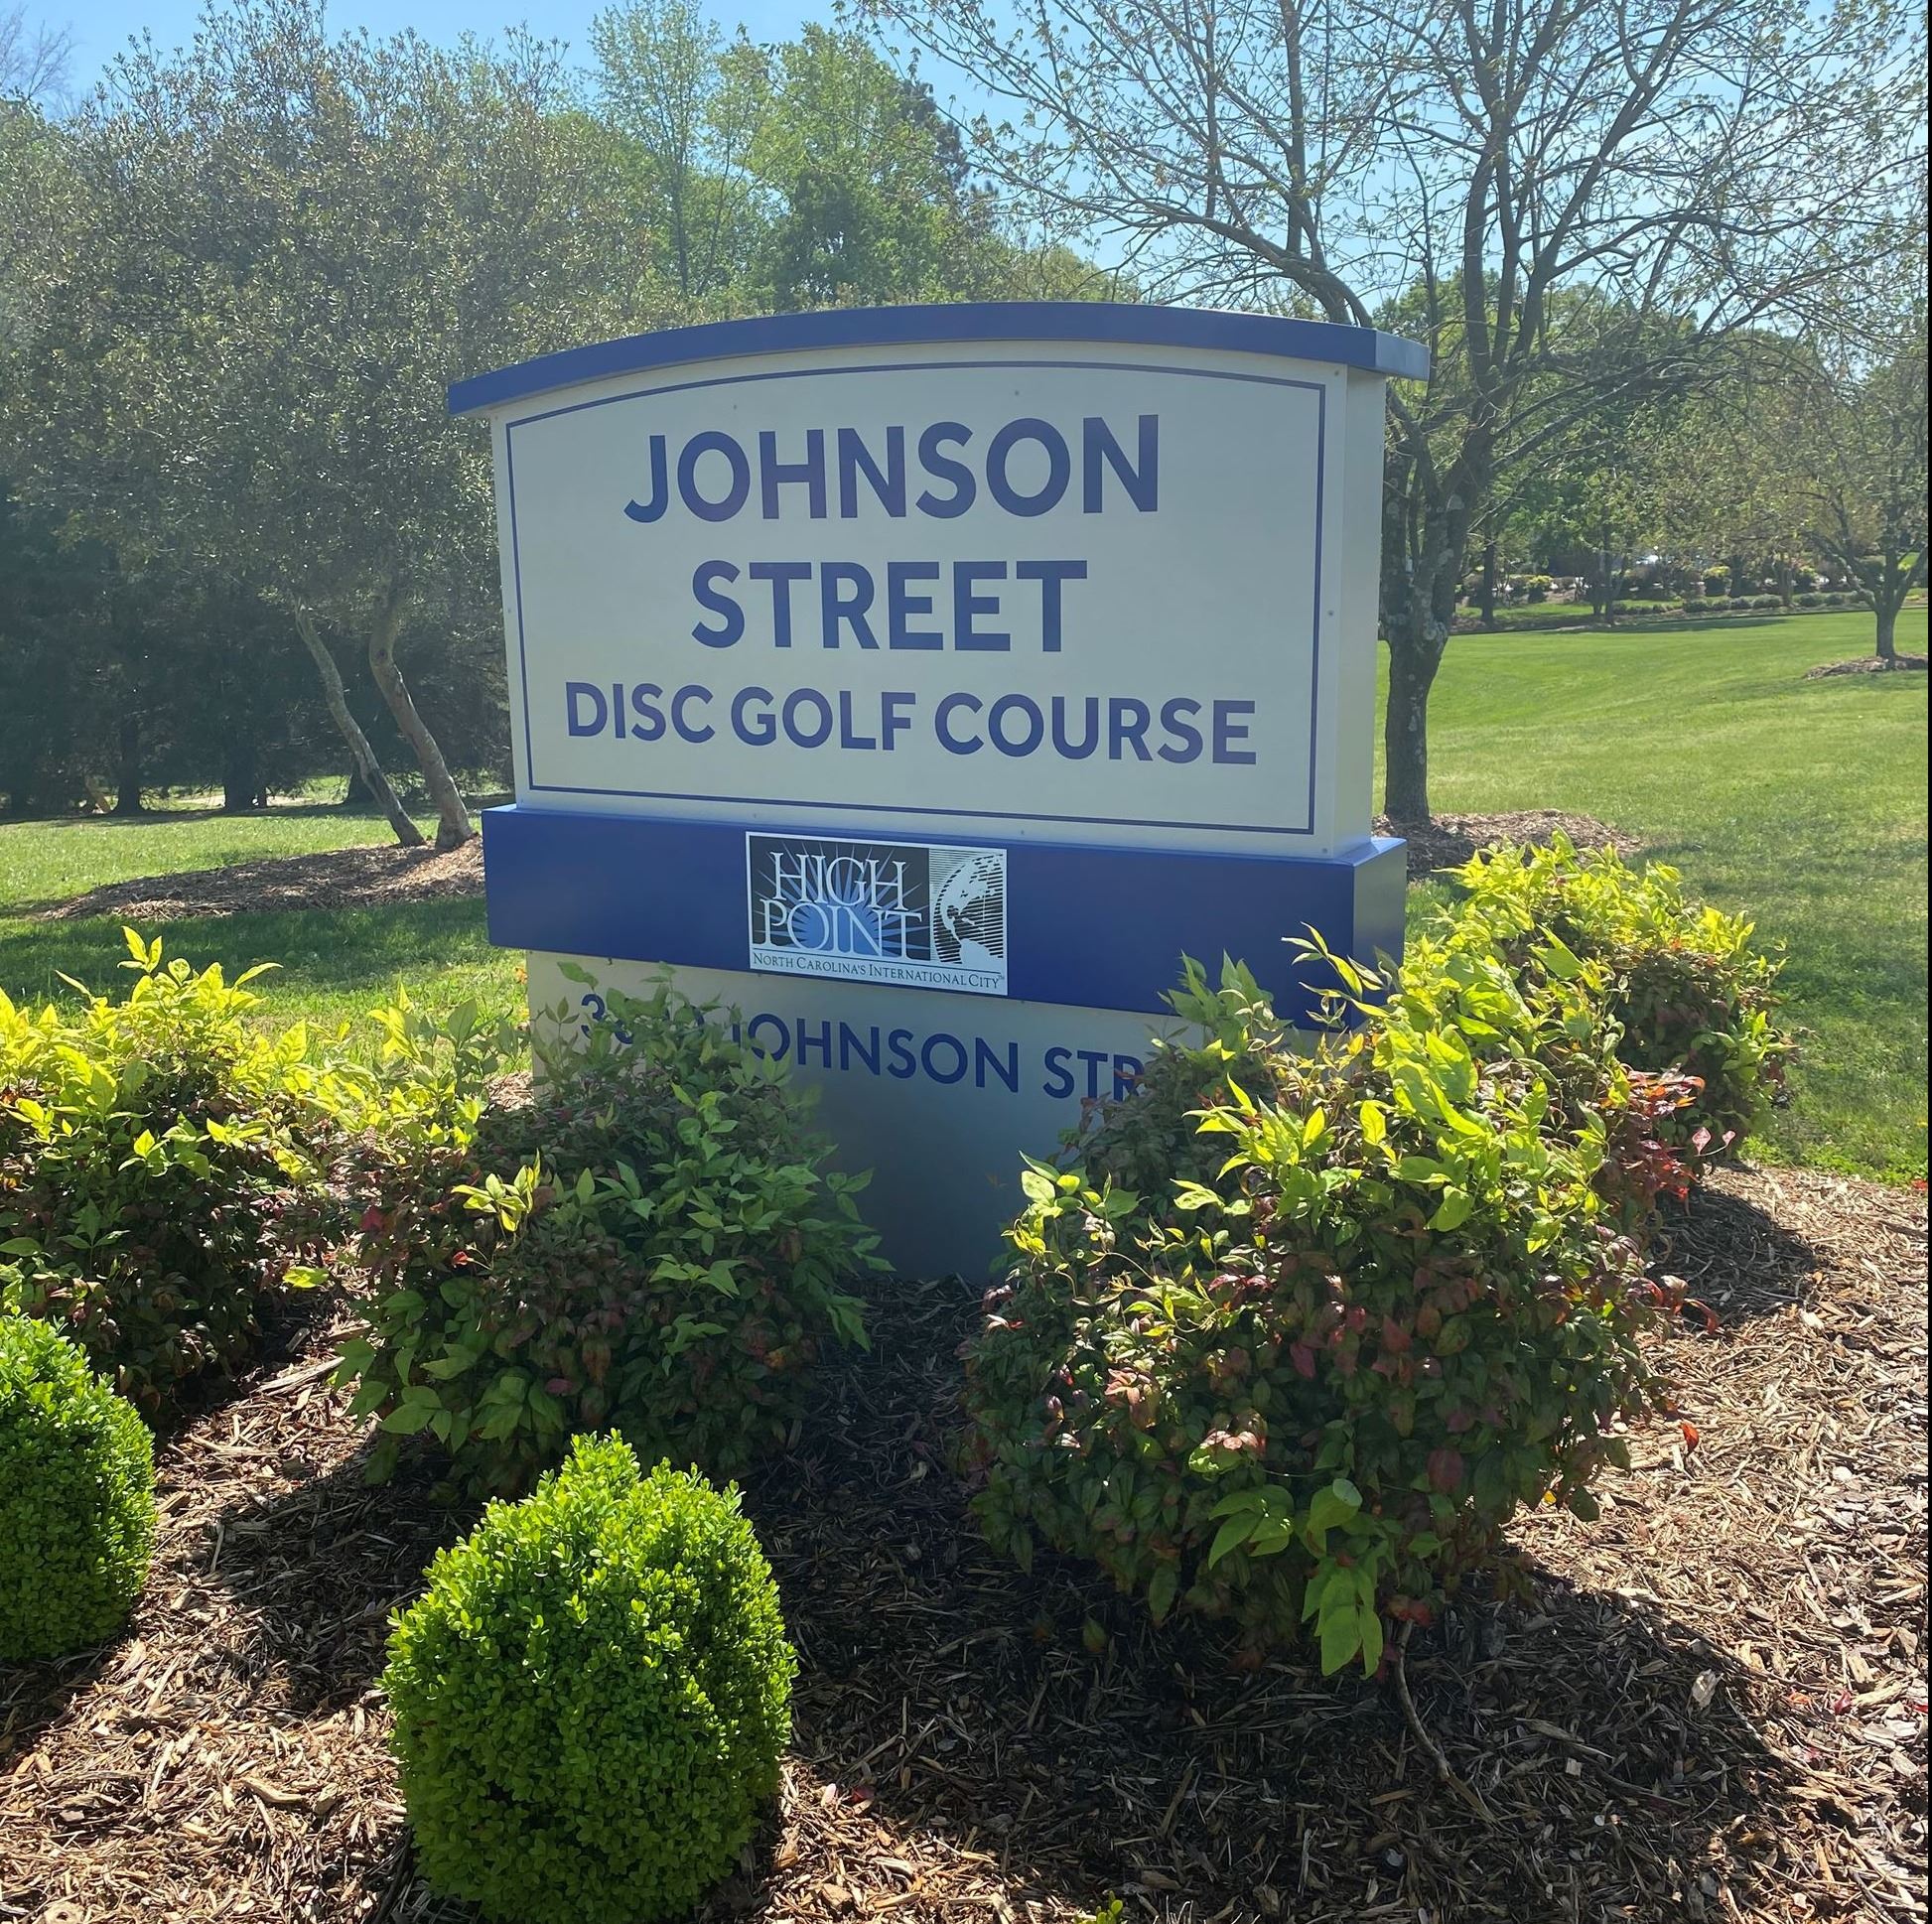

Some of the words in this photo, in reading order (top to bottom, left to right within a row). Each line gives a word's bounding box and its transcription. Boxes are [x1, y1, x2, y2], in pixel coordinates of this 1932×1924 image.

[623, 414, 1160, 523] JOHNSON
[691, 559, 1088, 652] STREET
[565, 681, 715, 744] DISC
[730, 686, 916, 752] GOLF
[934, 692, 1258, 765] COURSE
[769, 851, 906, 911] HIGH
[753, 898, 922, 961] POINT
[753, 953, 794, 969] NORTH
[796, 956, 867, 975] CAROLINA'S
[869, 964, 967, 986] INTERNATIONAL
[968, 974, 1000, 989] CITY
